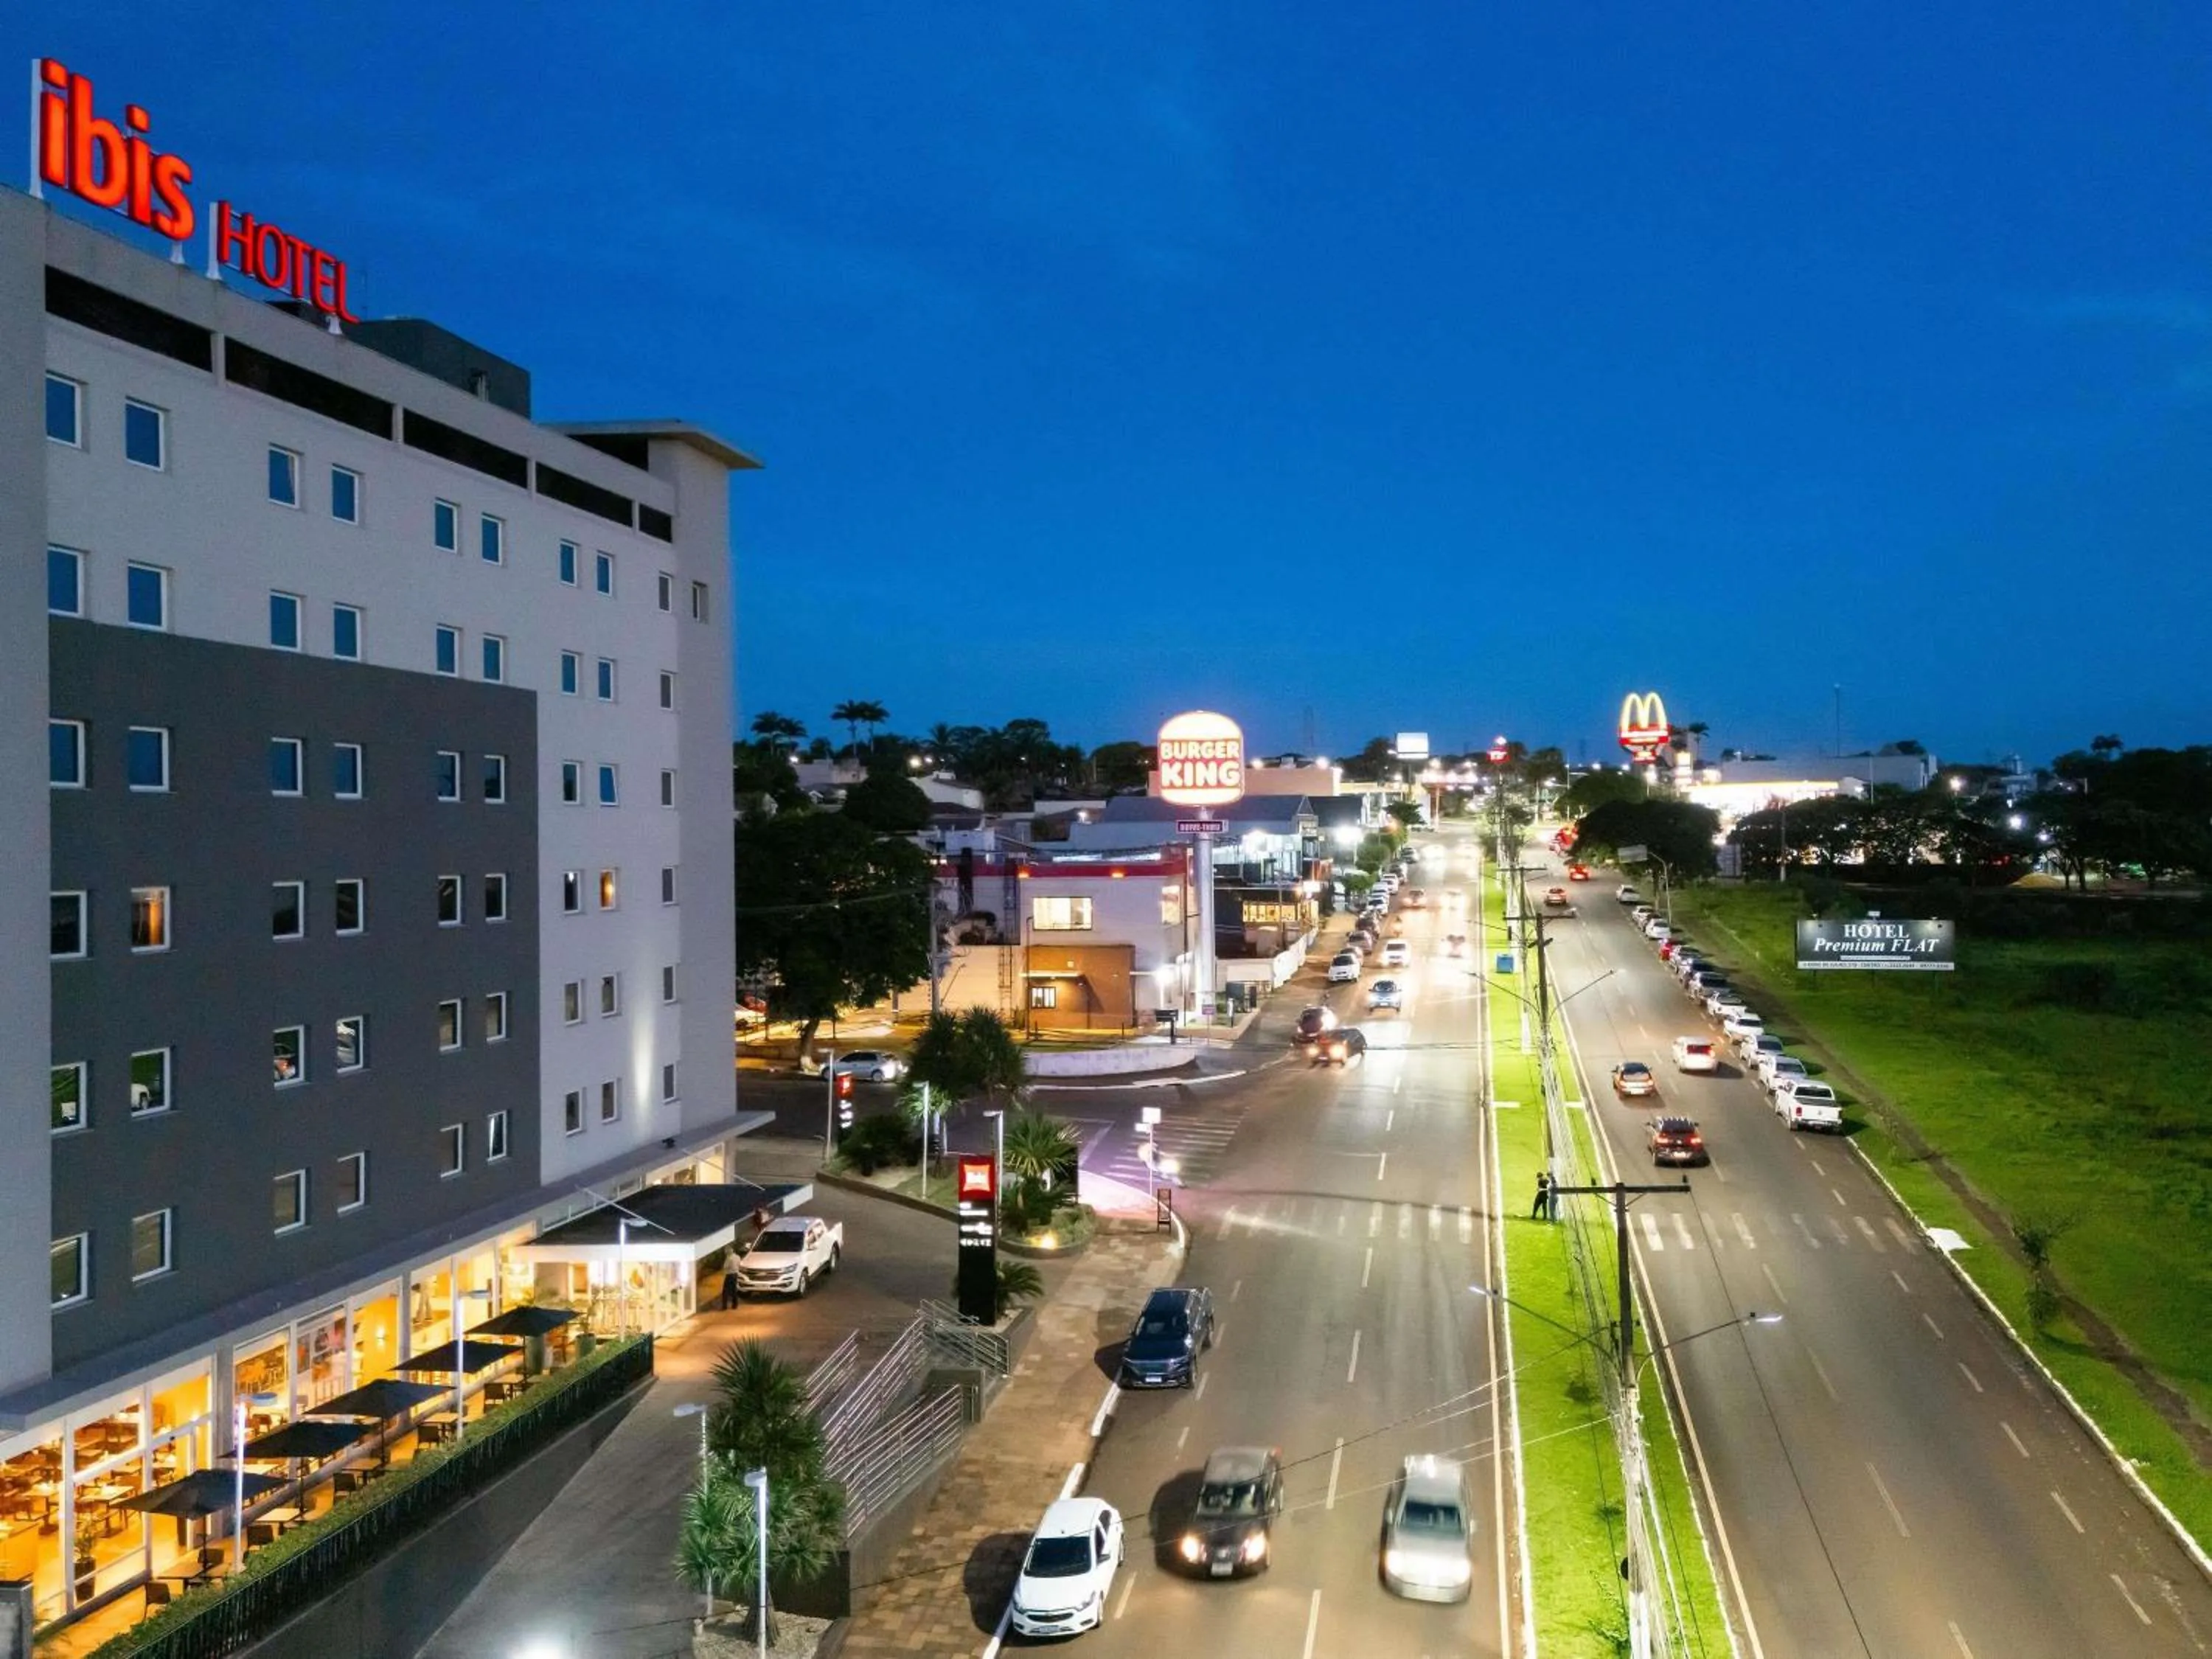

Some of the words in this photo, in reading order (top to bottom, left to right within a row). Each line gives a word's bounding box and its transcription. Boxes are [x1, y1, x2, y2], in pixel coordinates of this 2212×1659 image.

[40, 58, 195, 241] ibis
[218, 200, 359, 324] HOTEL
[1161, 741, 1239, 759] BURGER
[1161, 761, 1240, 787] KING
[1844, 924, 1910, 939] HOTEL
[1814, 937, 1886, 953] Premium
[1891, 939, 1940, 953] FLAT
